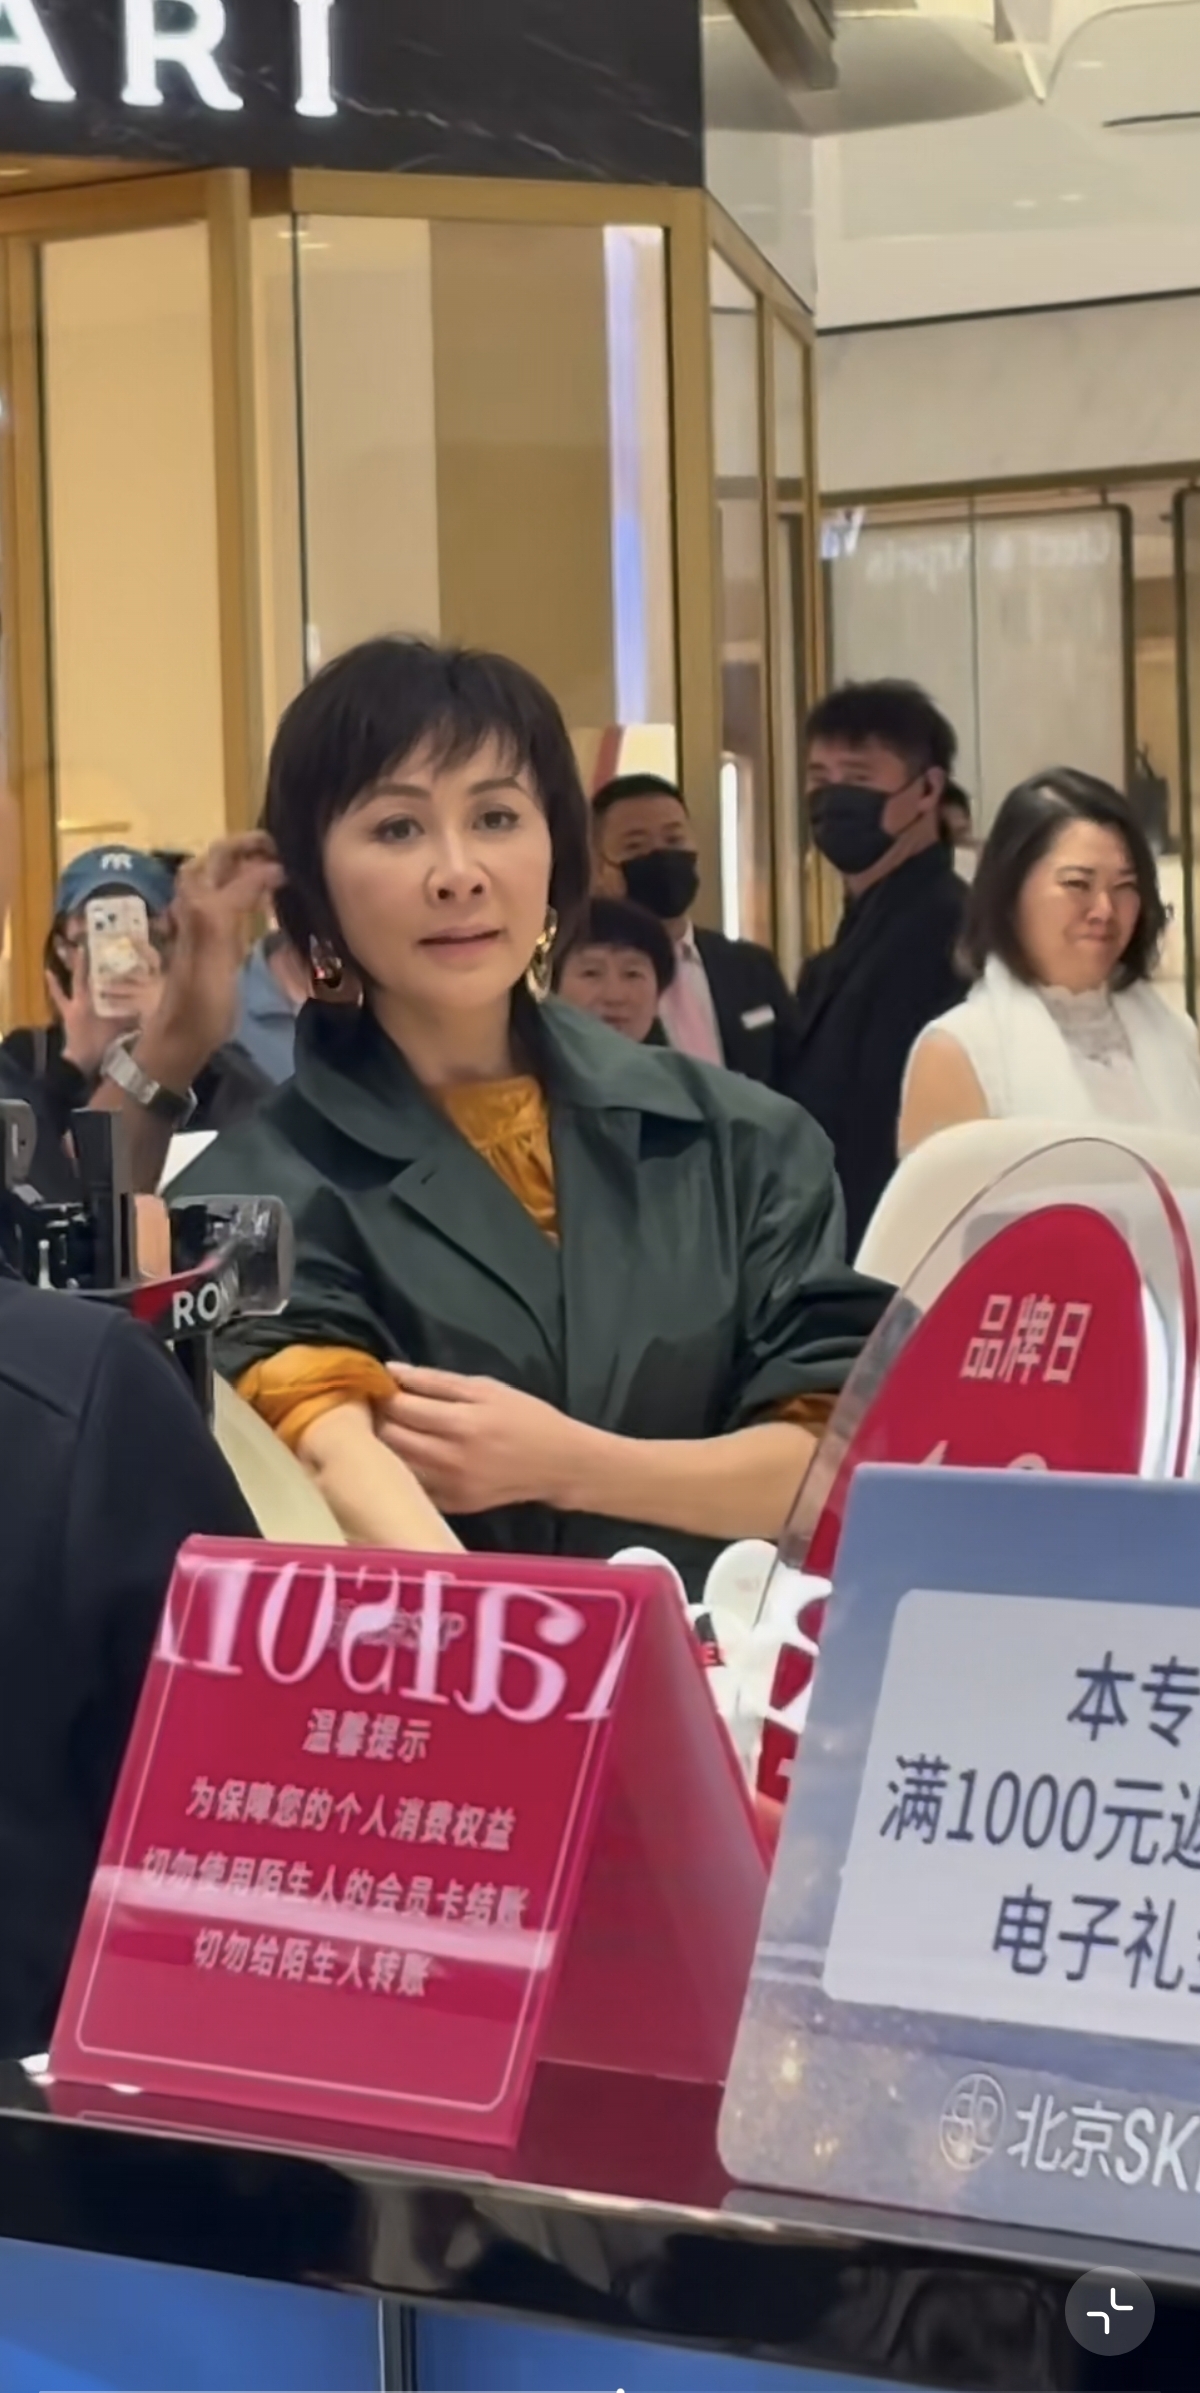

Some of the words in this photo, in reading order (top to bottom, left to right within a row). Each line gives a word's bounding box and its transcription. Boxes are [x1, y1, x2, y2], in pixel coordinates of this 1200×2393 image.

[960, 1293, 1092, 1385] 品牌日
[302, 1707, 432, 1763] 温馨提示
[1066, 1651, 1200, 1747] 本专
[185, 1776, 516, 1851] 为保障您的个人消费权益
[193, 1926, 432, 1997] 切勿给陌生人转账
[992, 1883, 1200, 1992] 电子礼
[1006, 2093, 1200, 2193] 北京SK
